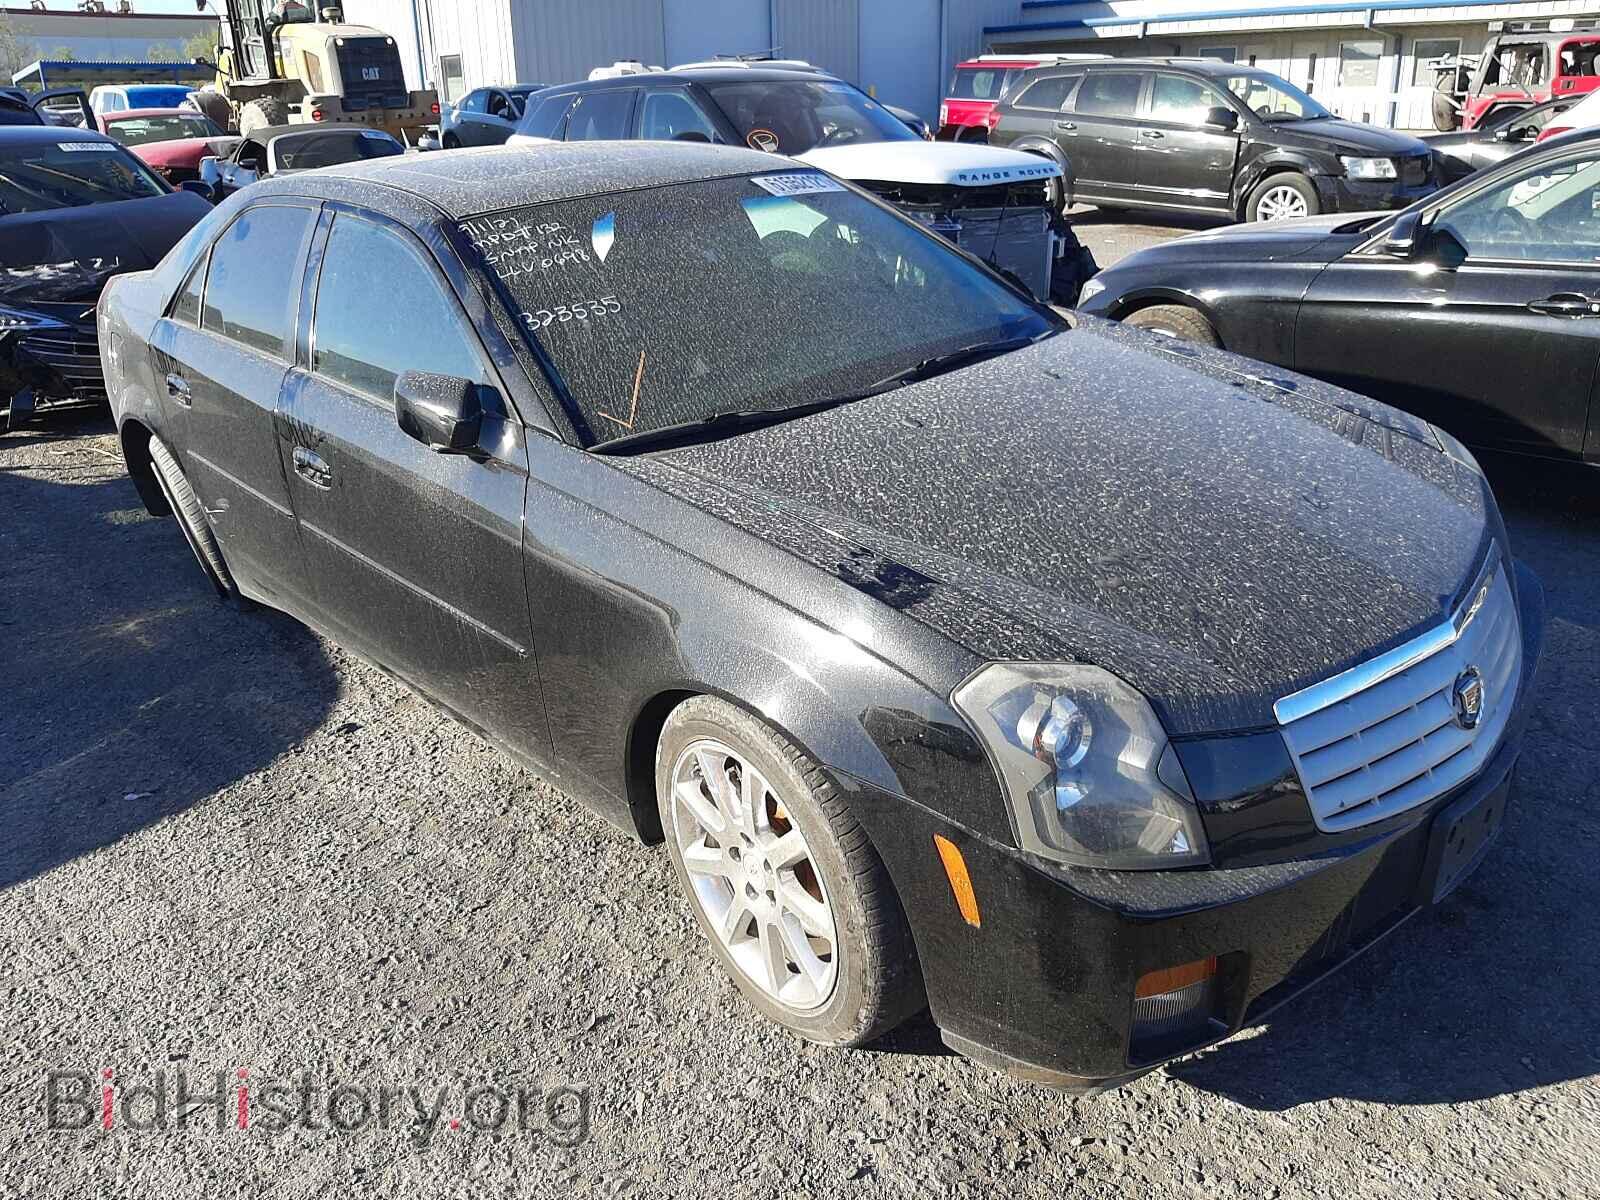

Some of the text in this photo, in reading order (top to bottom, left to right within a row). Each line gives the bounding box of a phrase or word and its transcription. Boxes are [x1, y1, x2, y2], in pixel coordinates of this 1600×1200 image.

[362, 67, 380, 80] CAT
[959, 167, 1056, 182] RANGE ROVER
[519, 295, 621, 330] 323535
